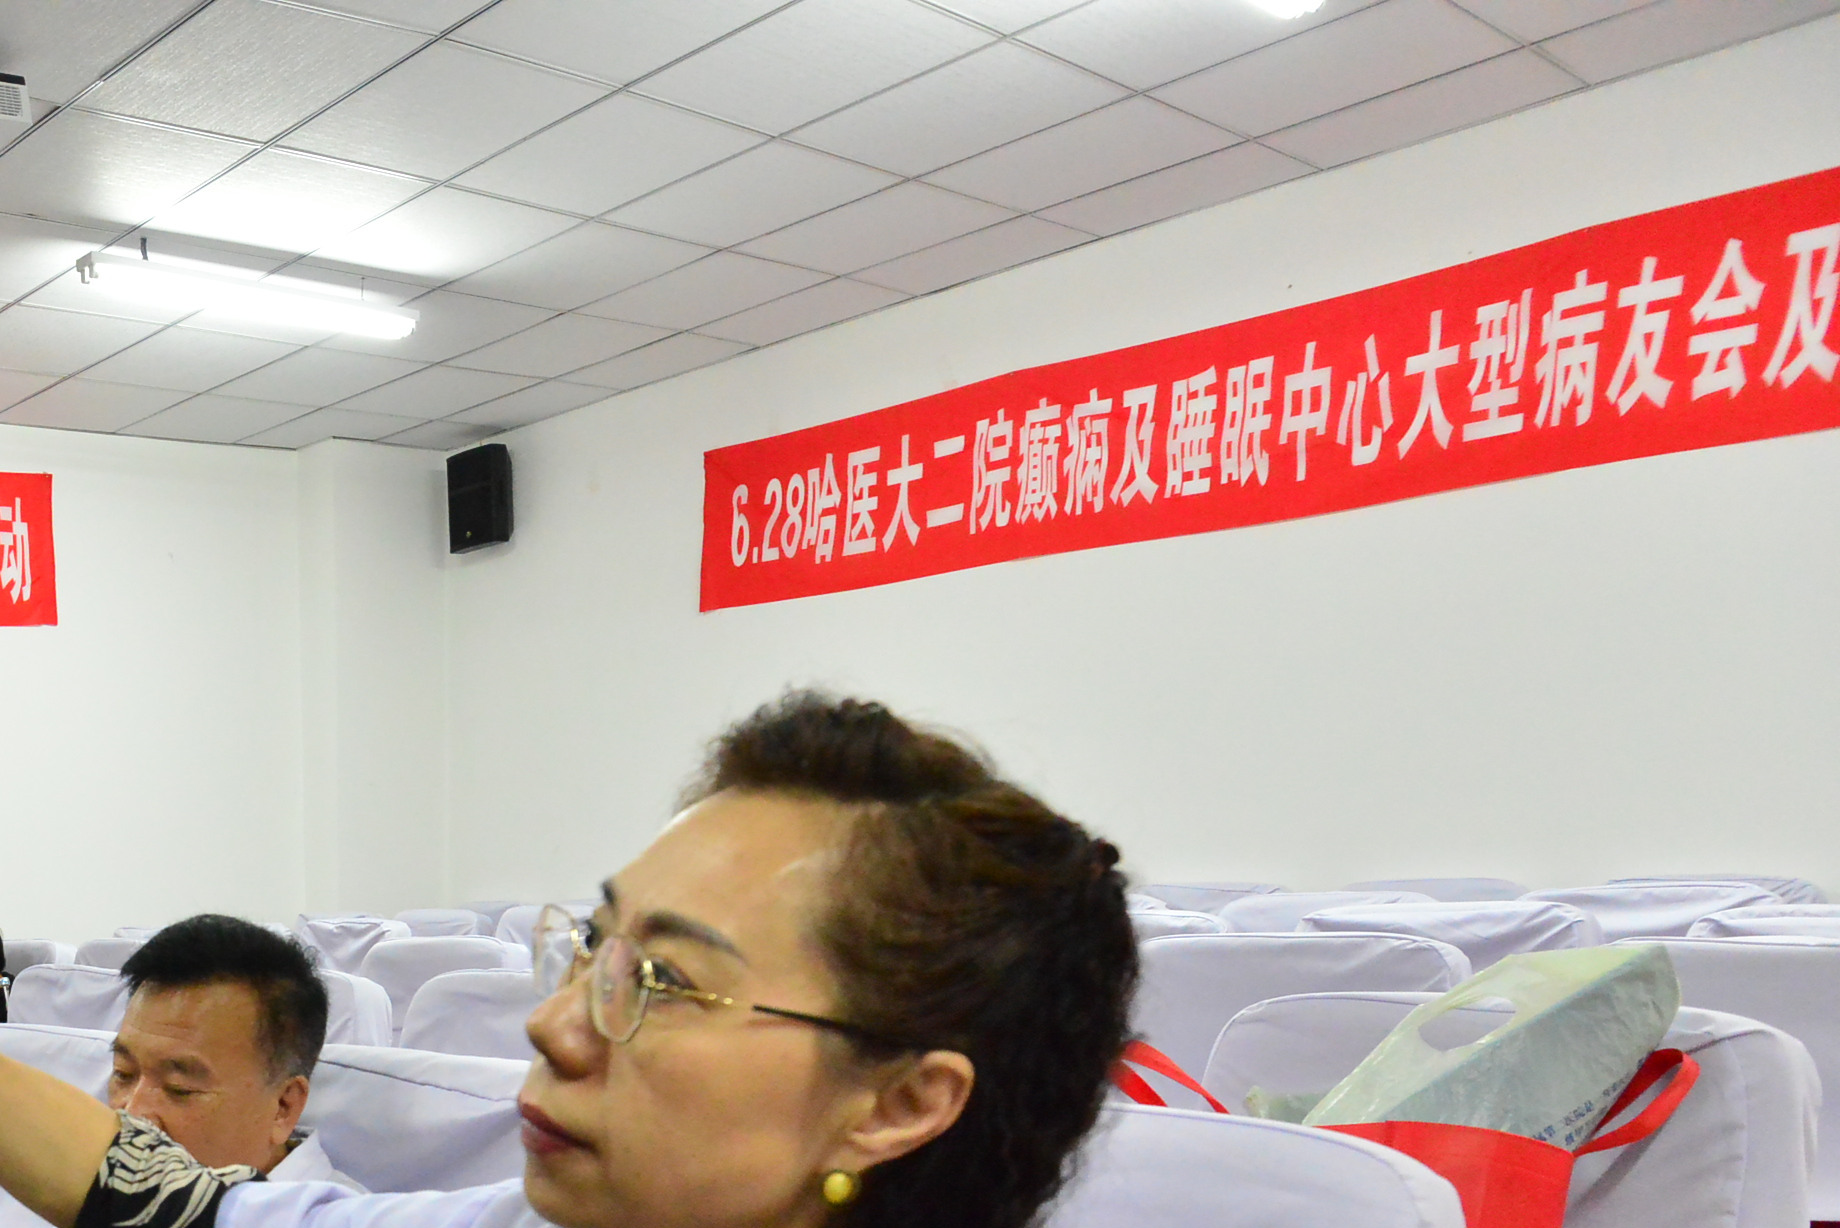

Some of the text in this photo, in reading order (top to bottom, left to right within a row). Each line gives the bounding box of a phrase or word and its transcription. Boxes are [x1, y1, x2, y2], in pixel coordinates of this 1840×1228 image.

[729, 222, 1840, 568] 6.28哈医大二院癫痫及睡眠中心大型病友会及
